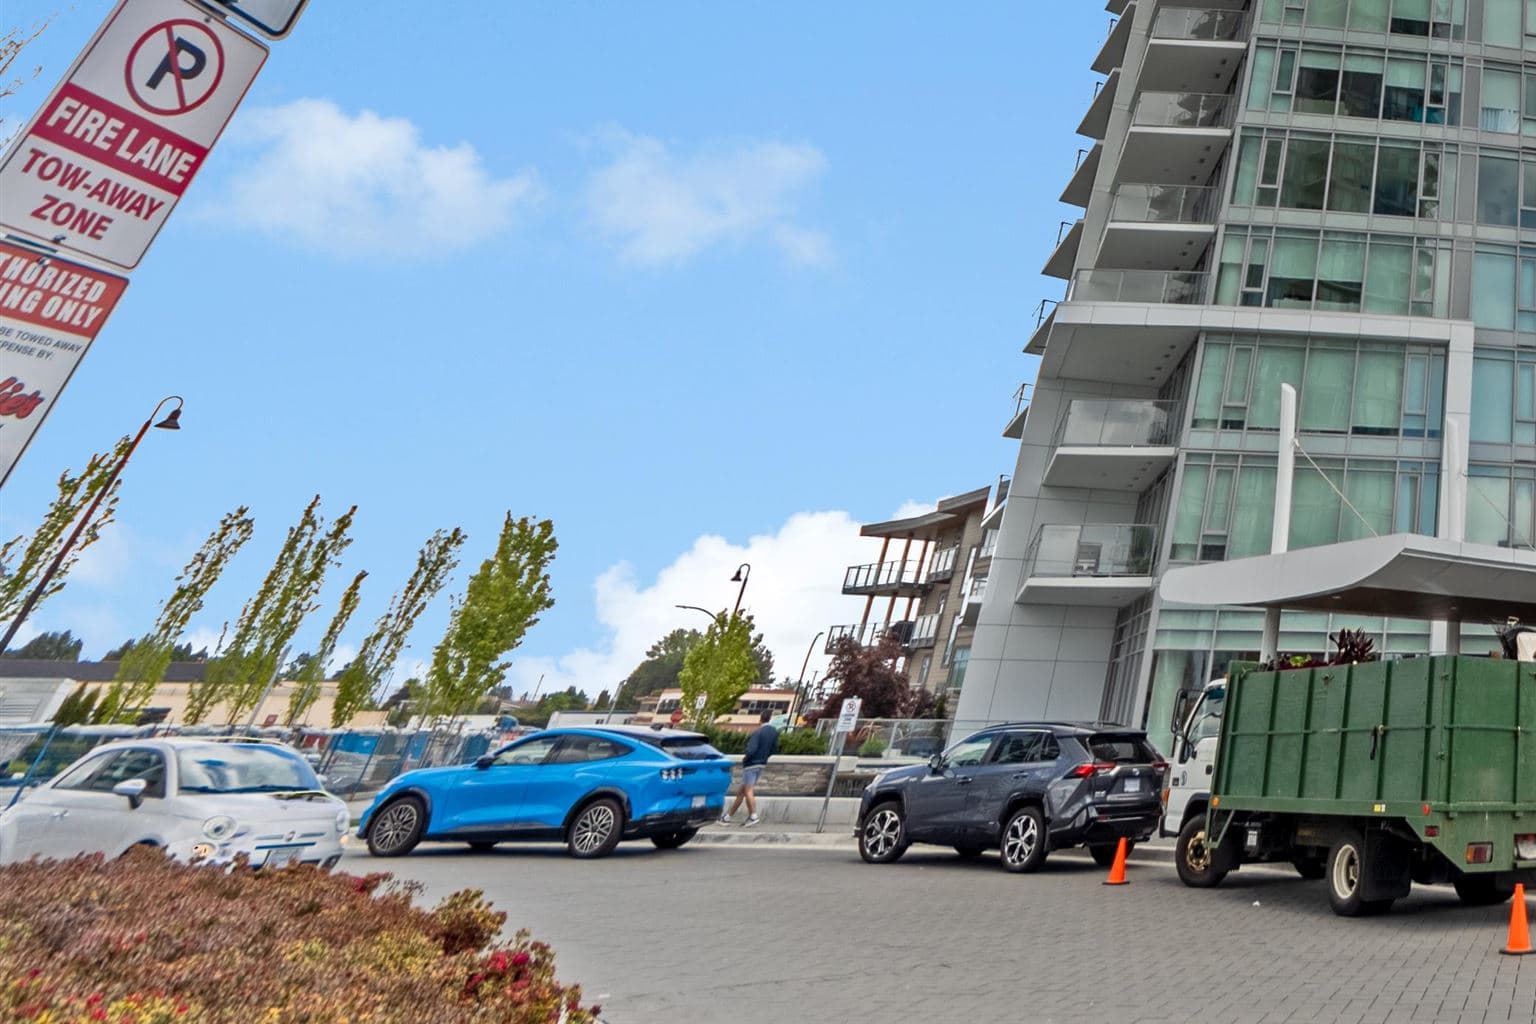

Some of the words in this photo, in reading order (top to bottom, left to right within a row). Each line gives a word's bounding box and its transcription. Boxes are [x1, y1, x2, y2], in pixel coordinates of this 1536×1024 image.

[46, 96, 125, 151] FIRE
[116, 128, 197, 184] LANE
[22, 148, 165, 221] TOW-AWAY
[30, 194, 114, 240] ZONE
[0, 280, 43, 314] ING
[41, 296, 103, 329] ONLY
[0, 339, 36, 357] PENSE
[15, 330, 53, 347] TOWED
[53, 340, 83, 353] AWAY
